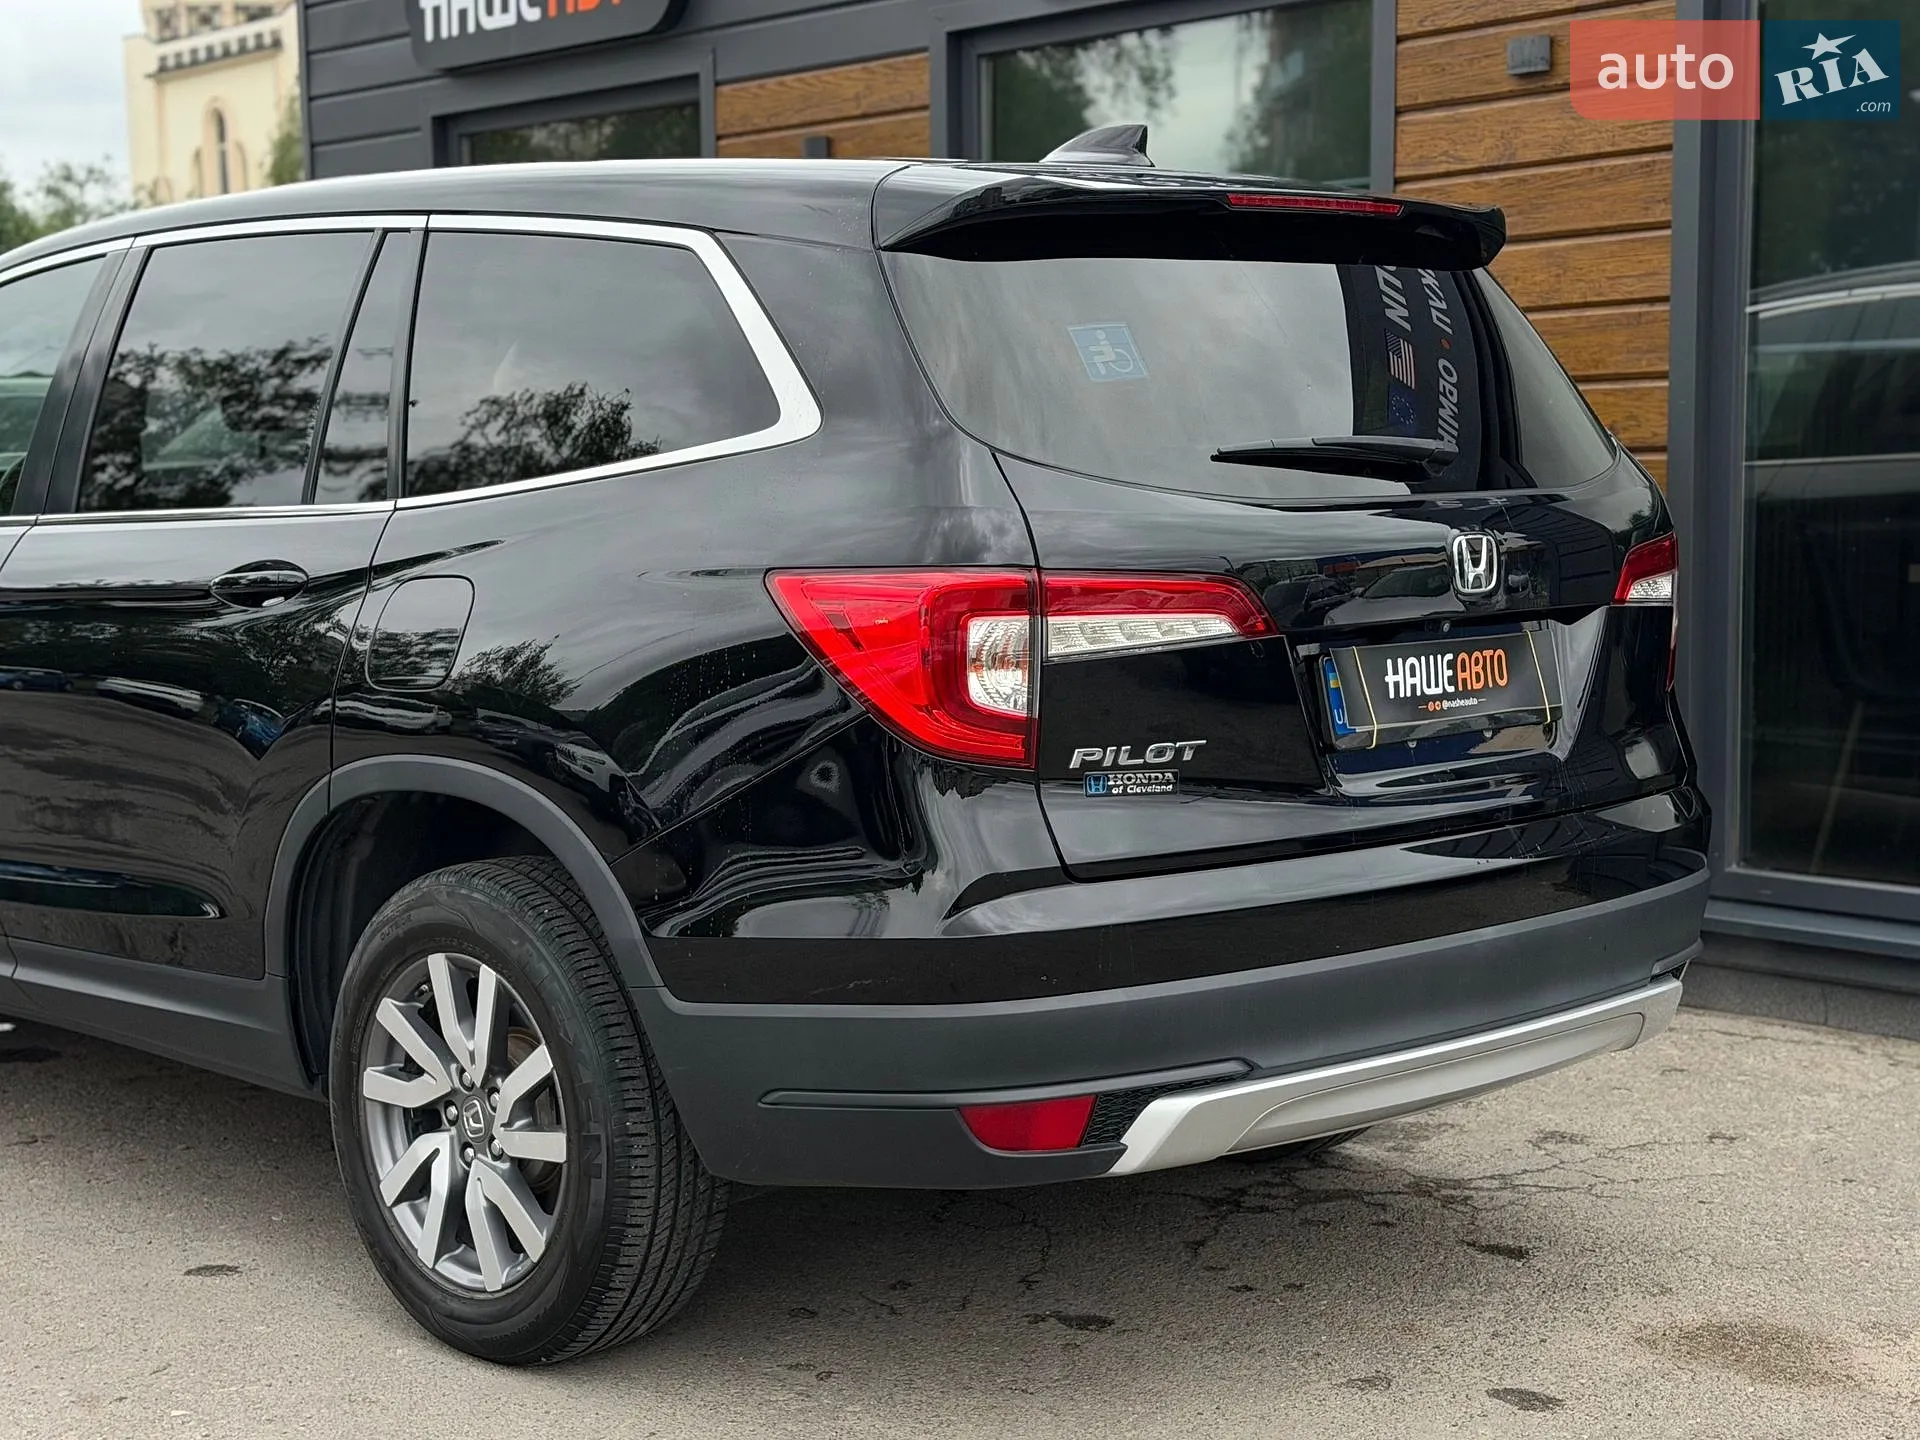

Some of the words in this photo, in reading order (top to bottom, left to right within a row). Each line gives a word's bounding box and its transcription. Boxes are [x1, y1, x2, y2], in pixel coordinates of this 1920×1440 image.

[1069, 740, 1207, 768] PILOT
[1108, 772, 1176, 785] HONDA
[1112, 785, 1124, 794] of
[1127, 783, 1172, 793] Cleveland
